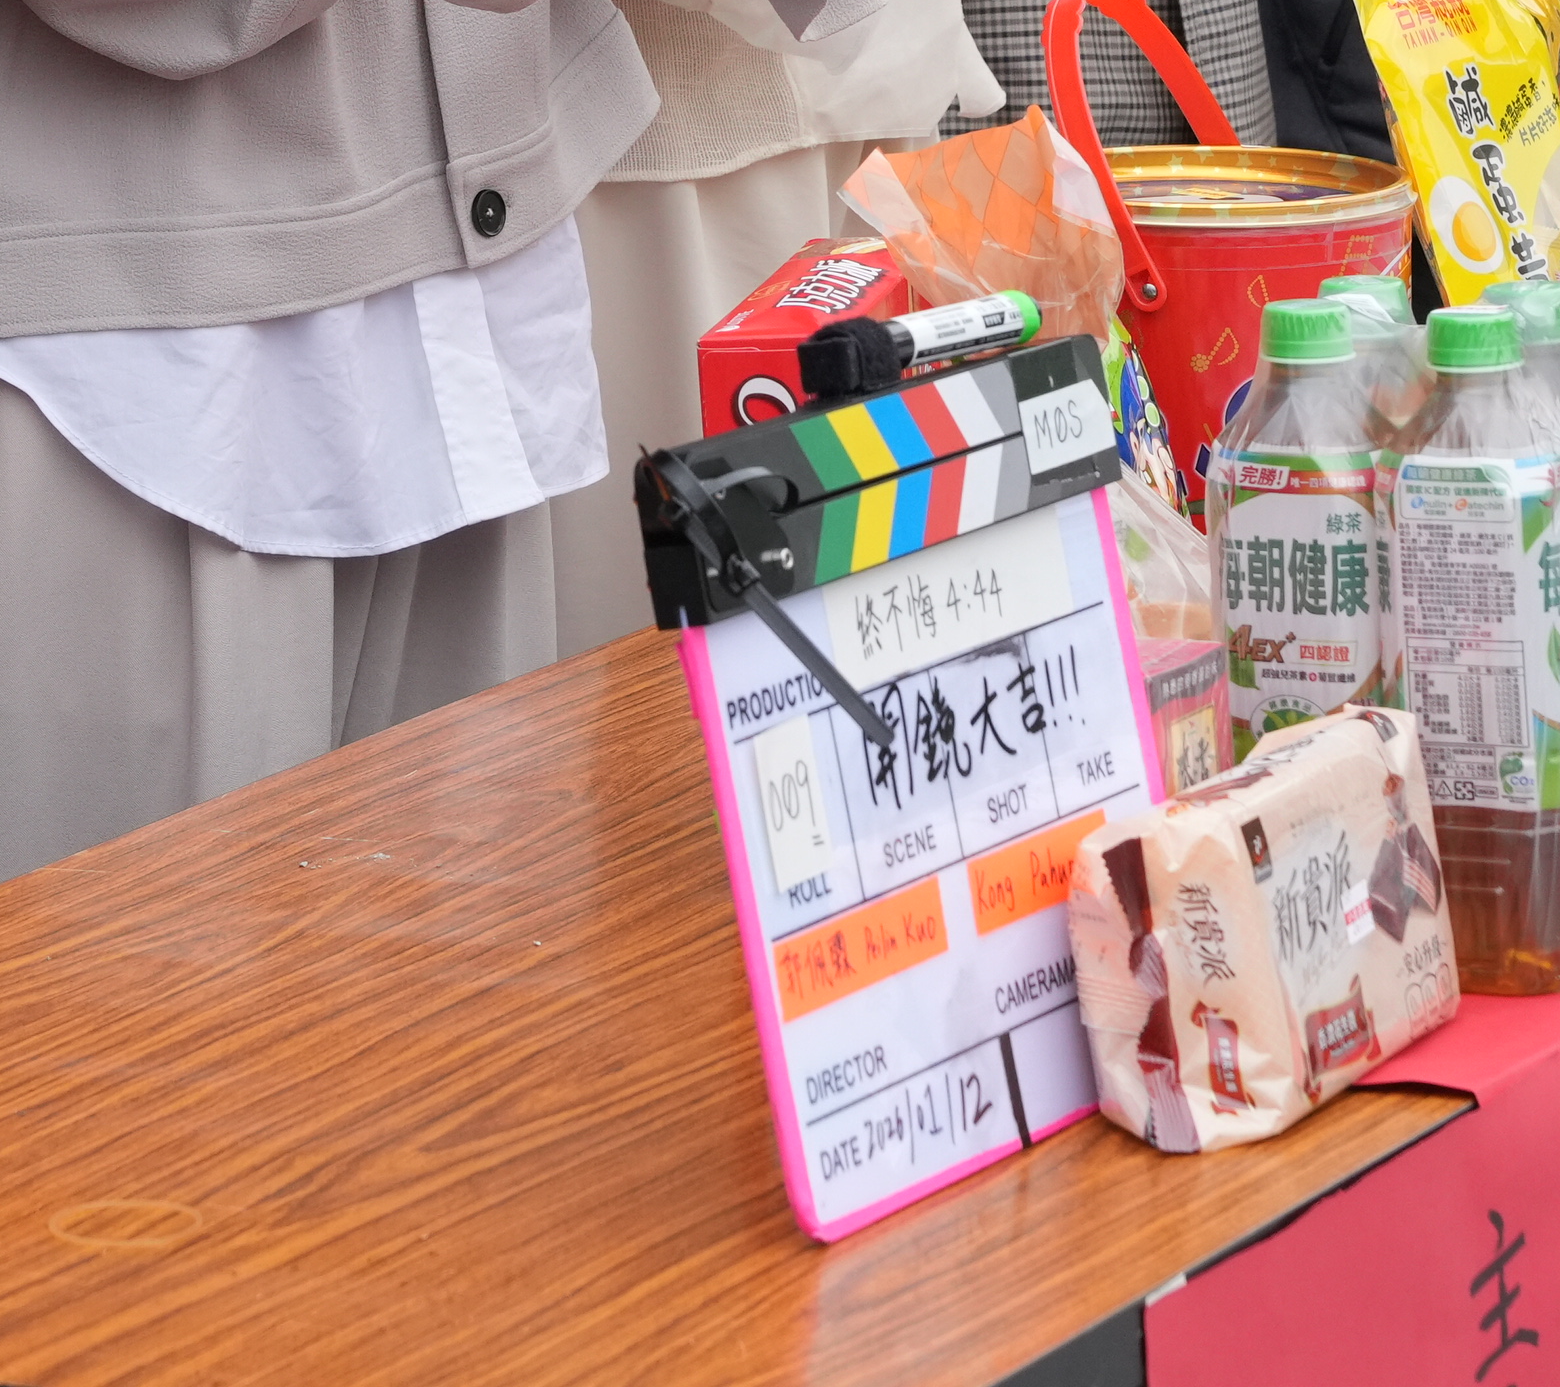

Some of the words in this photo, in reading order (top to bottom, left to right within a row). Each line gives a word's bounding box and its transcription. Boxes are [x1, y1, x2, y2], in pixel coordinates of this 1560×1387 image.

[1239, 465, 1285, 487] 完勝!
[1326, 512, 1362, 535] 綠茶
[854, 573, 937, 659] 終不悔
[945, 567, 1004, 618] 4:44
[1300, 644, 1350, 663] 四認證
[727, 673, 830, 730] PRODUCTIO
[1076, 751, 1116, 788] TAKE
[768, 758, 816, 832] 009
[987, 784, 1029, 825] SHOT
[883, 824, 938, 869] SCENE
[974, 868, 1016, 916] Kong
[902, 911, 938, 948] Kuo
[994, 954, 1077, 1015] CAMERAMA
[806, 1044, 888, 1105] DIRECTOR
[819, 1134, 863, 1182] DATE
[863, 1073, 994, 1165] 2026/01/12
